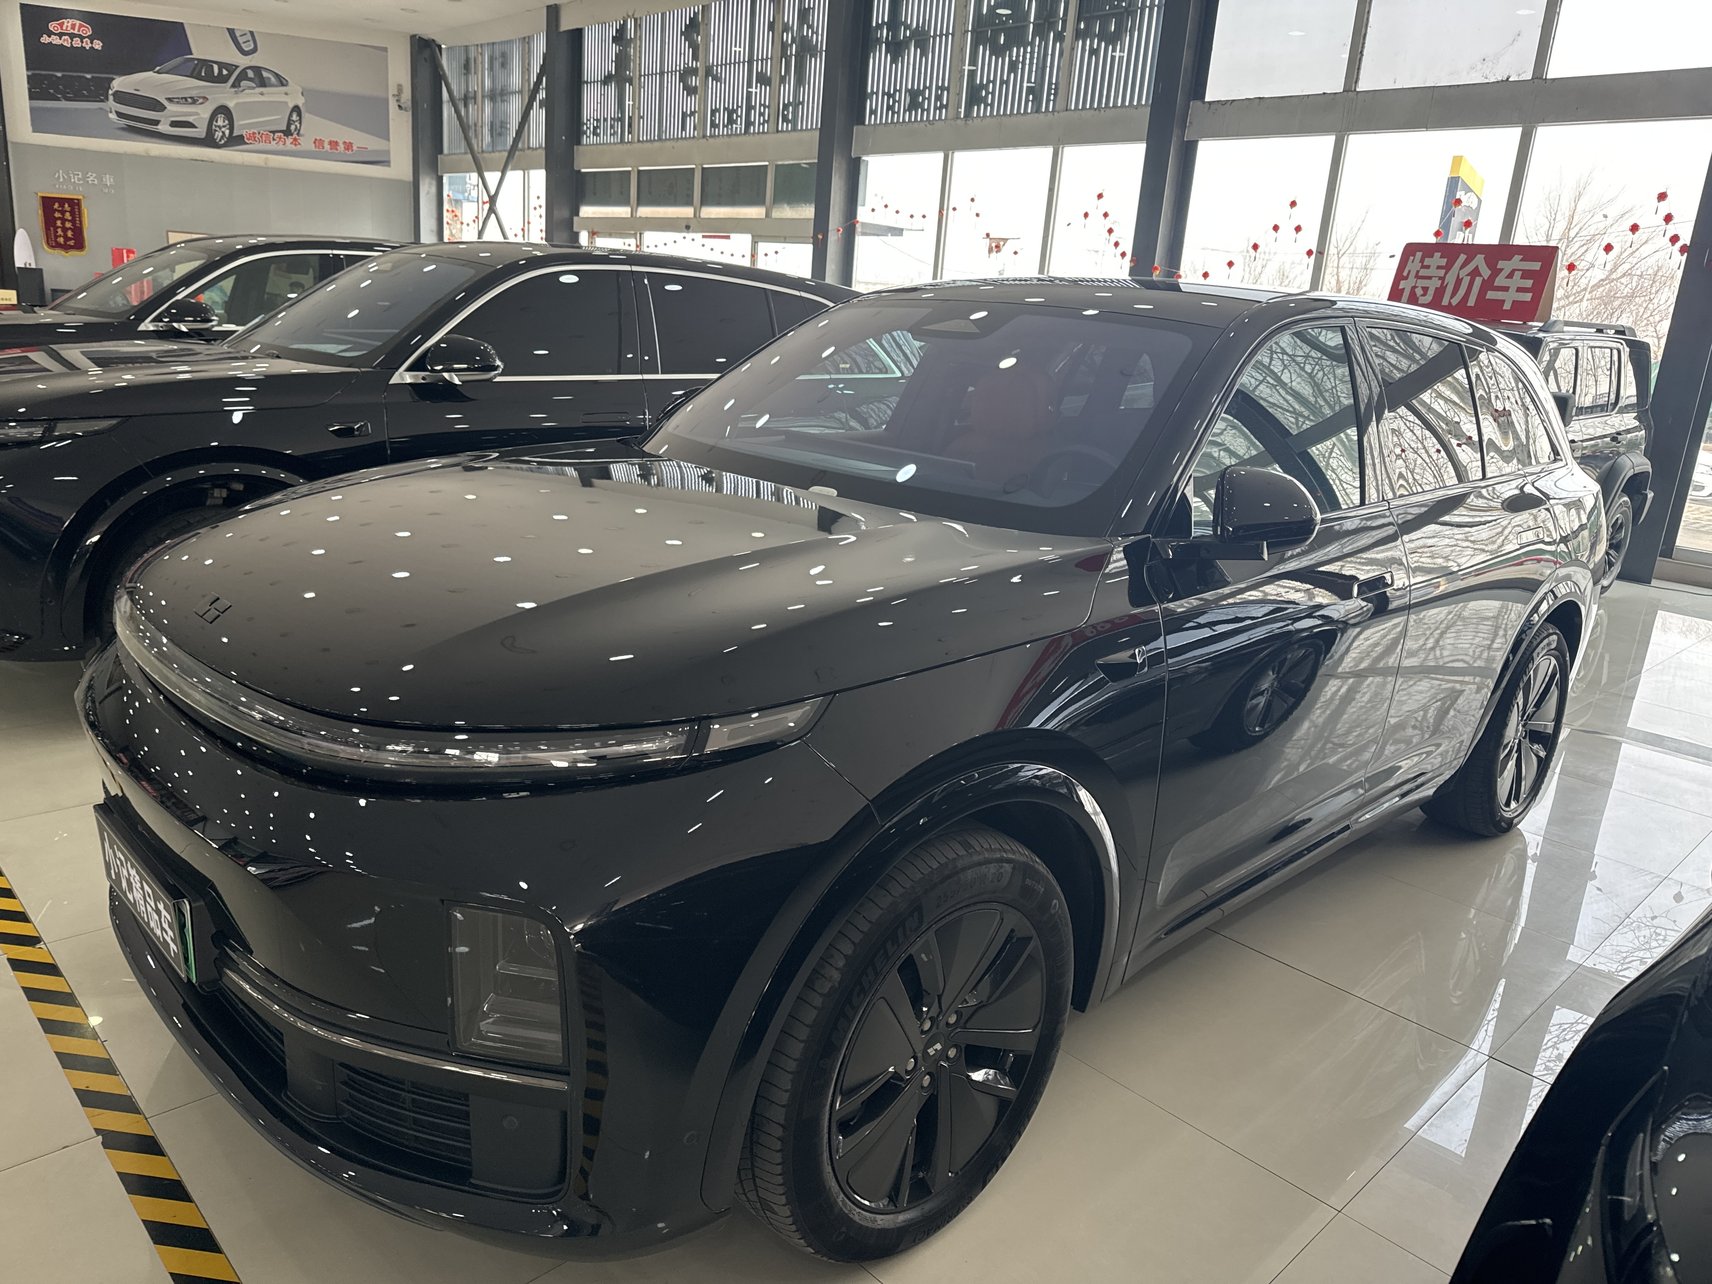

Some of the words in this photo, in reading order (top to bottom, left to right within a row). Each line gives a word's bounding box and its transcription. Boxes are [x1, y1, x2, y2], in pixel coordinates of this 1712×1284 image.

[40, 34, 103, 50] 小记精品车行
[244, 130, 301, 147] 诚信为本
[312, 137, 369, 153] 信誉第一
[1398, 251, 1542, 310] 特价车
[103, 831, 178, 958] 小记精品车
